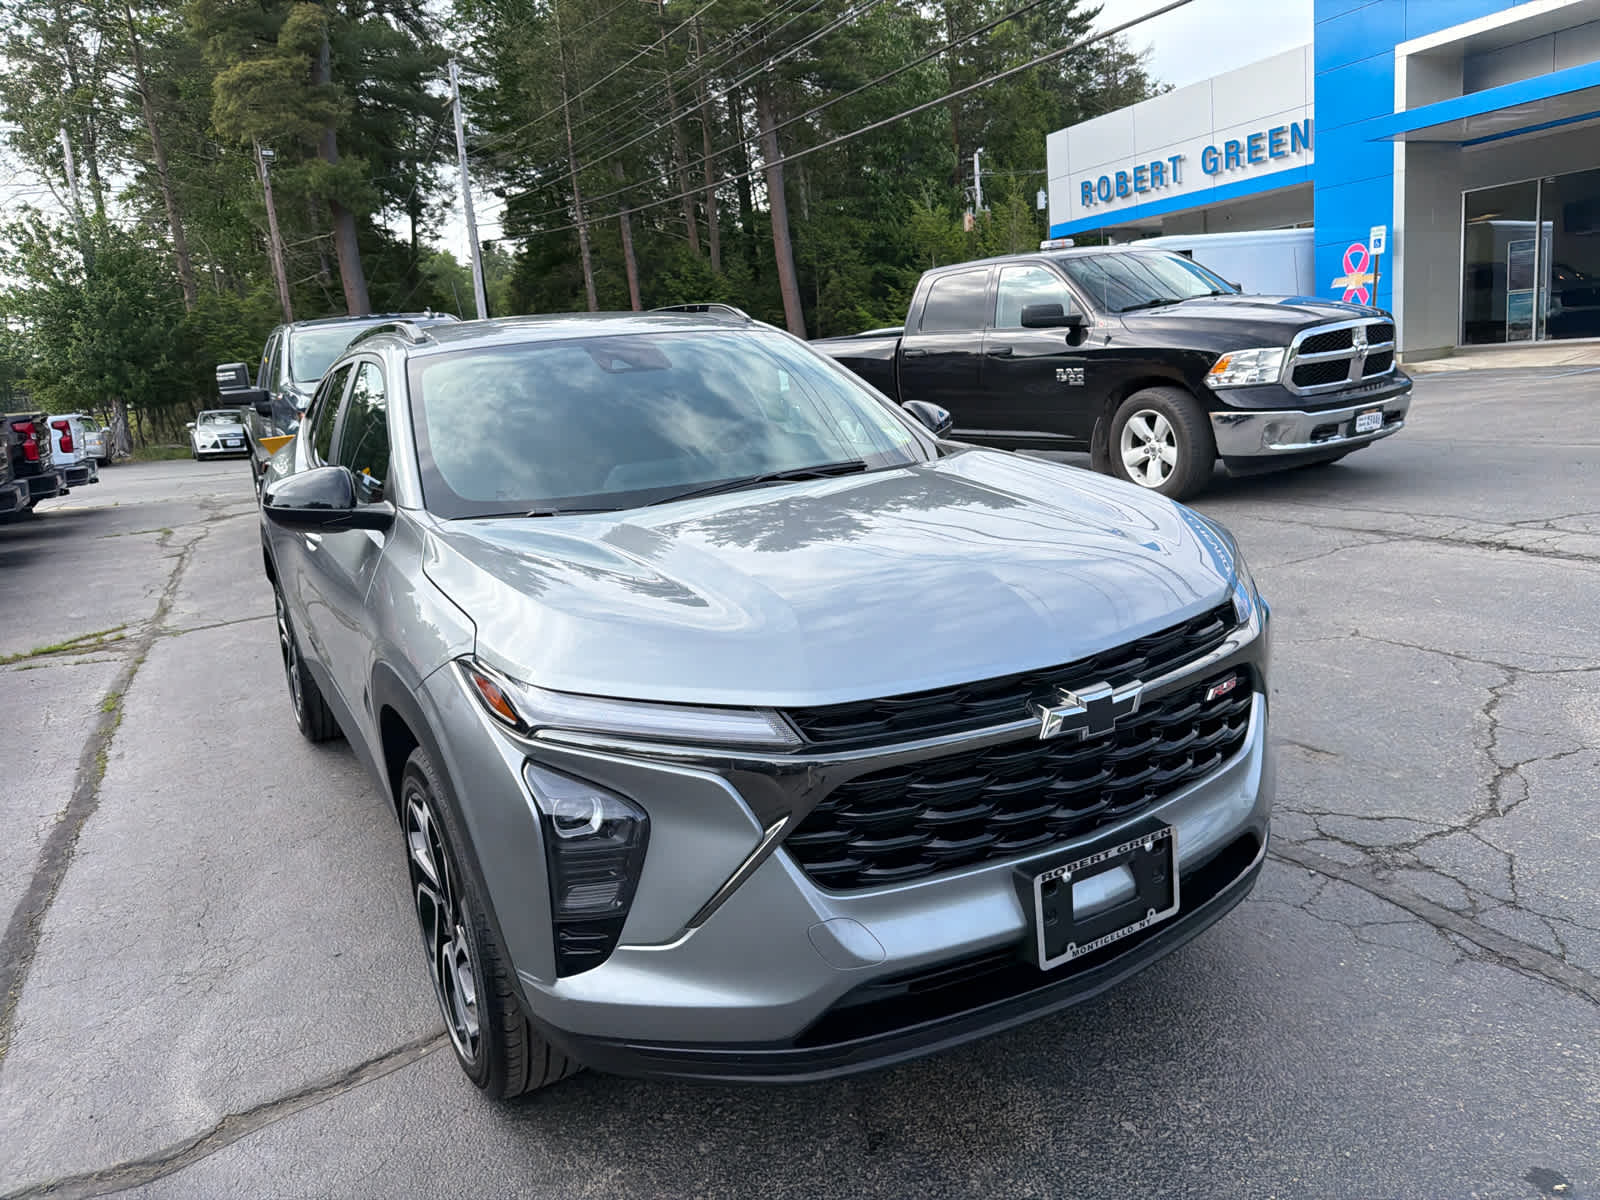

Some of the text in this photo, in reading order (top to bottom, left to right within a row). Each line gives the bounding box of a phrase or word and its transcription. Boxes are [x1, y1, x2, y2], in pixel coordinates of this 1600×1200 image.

[1081, 118, 1314, 207] ROBERT GREEN
[1041, 827, 1172, 882] ROBERT GREEN
[1071, 926, 1134, 958] MONTICELLO
